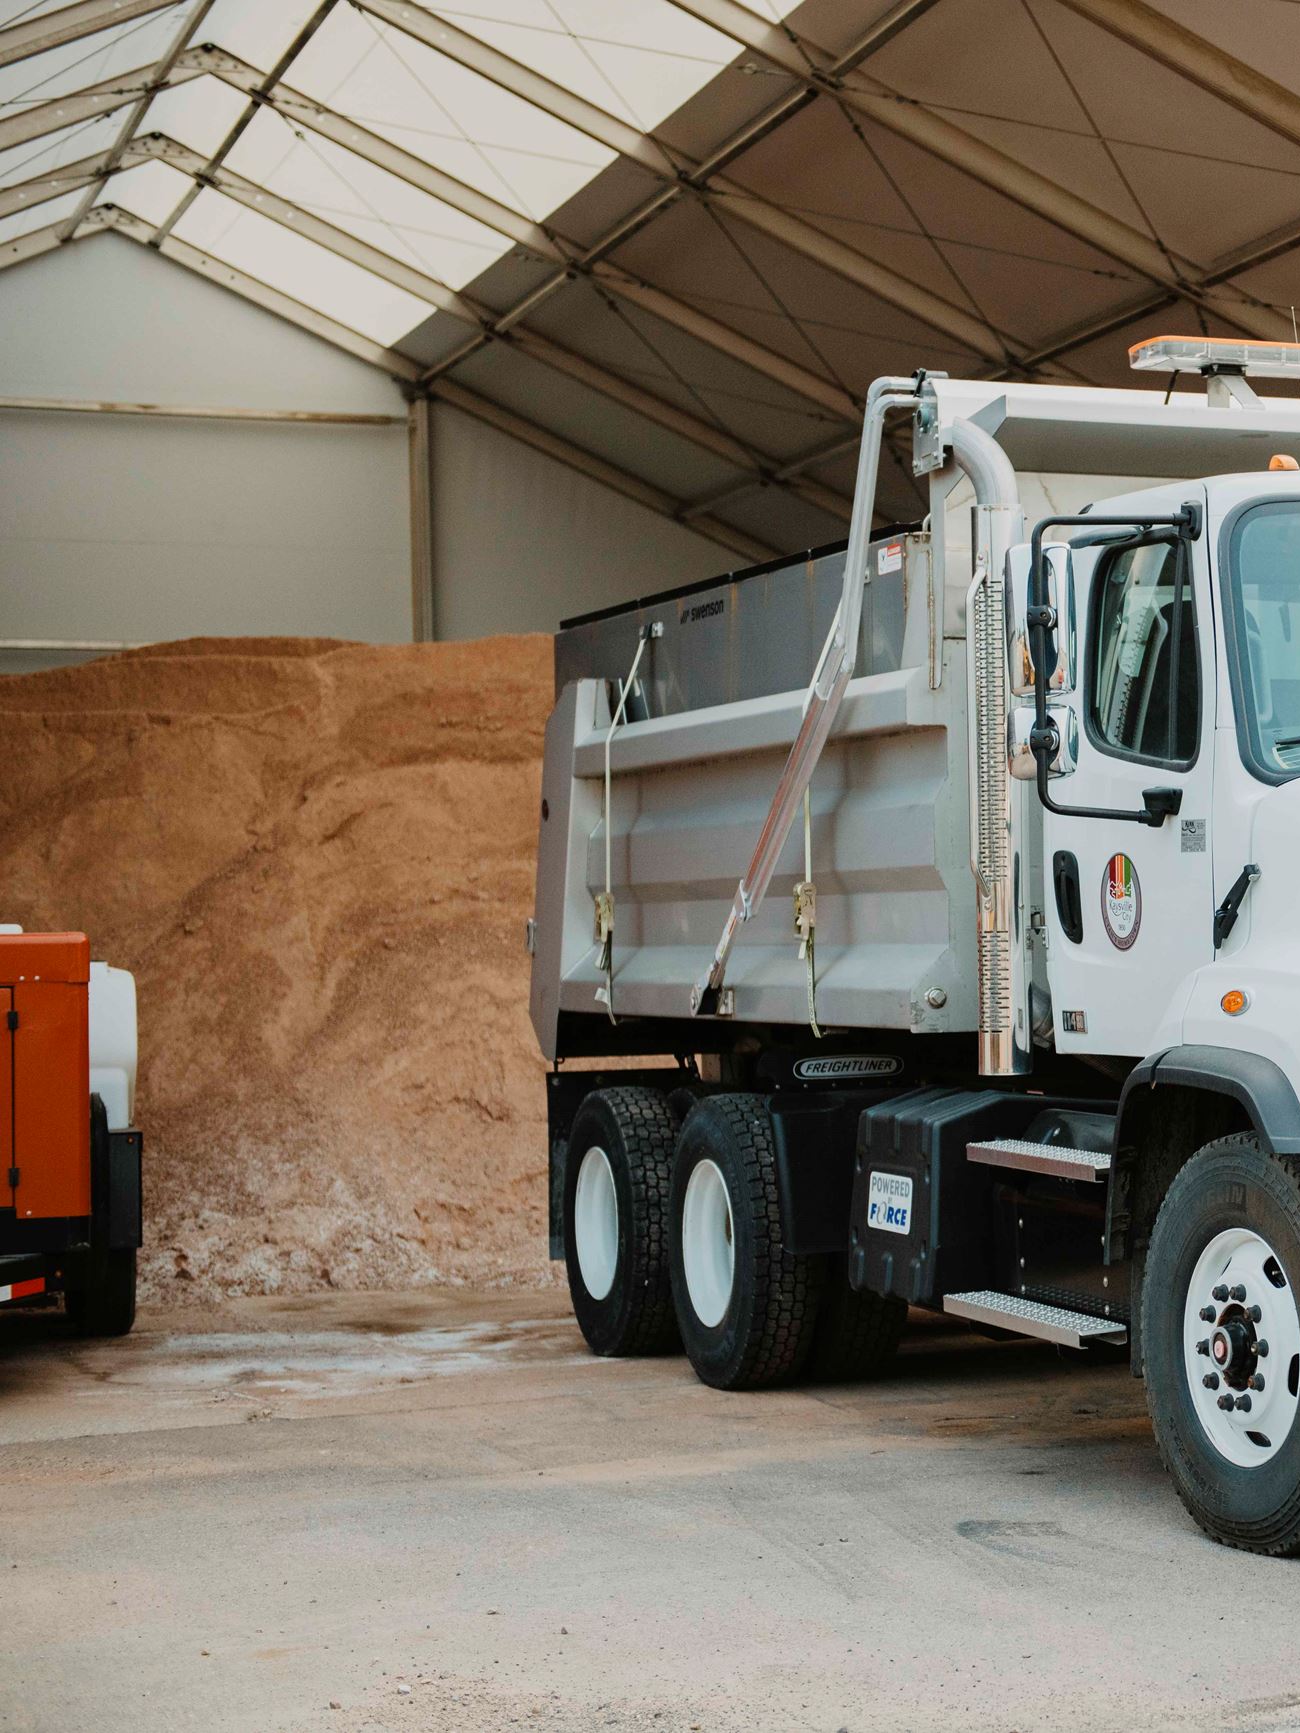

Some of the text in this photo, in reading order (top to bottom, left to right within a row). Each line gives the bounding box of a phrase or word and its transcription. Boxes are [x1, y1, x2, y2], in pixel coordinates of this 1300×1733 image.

[690, 600, 724, 621] swenson
[805, 1059, 893, 1074] FREIGHTLINER
[871, 1176, 910, 1198] POWERED
